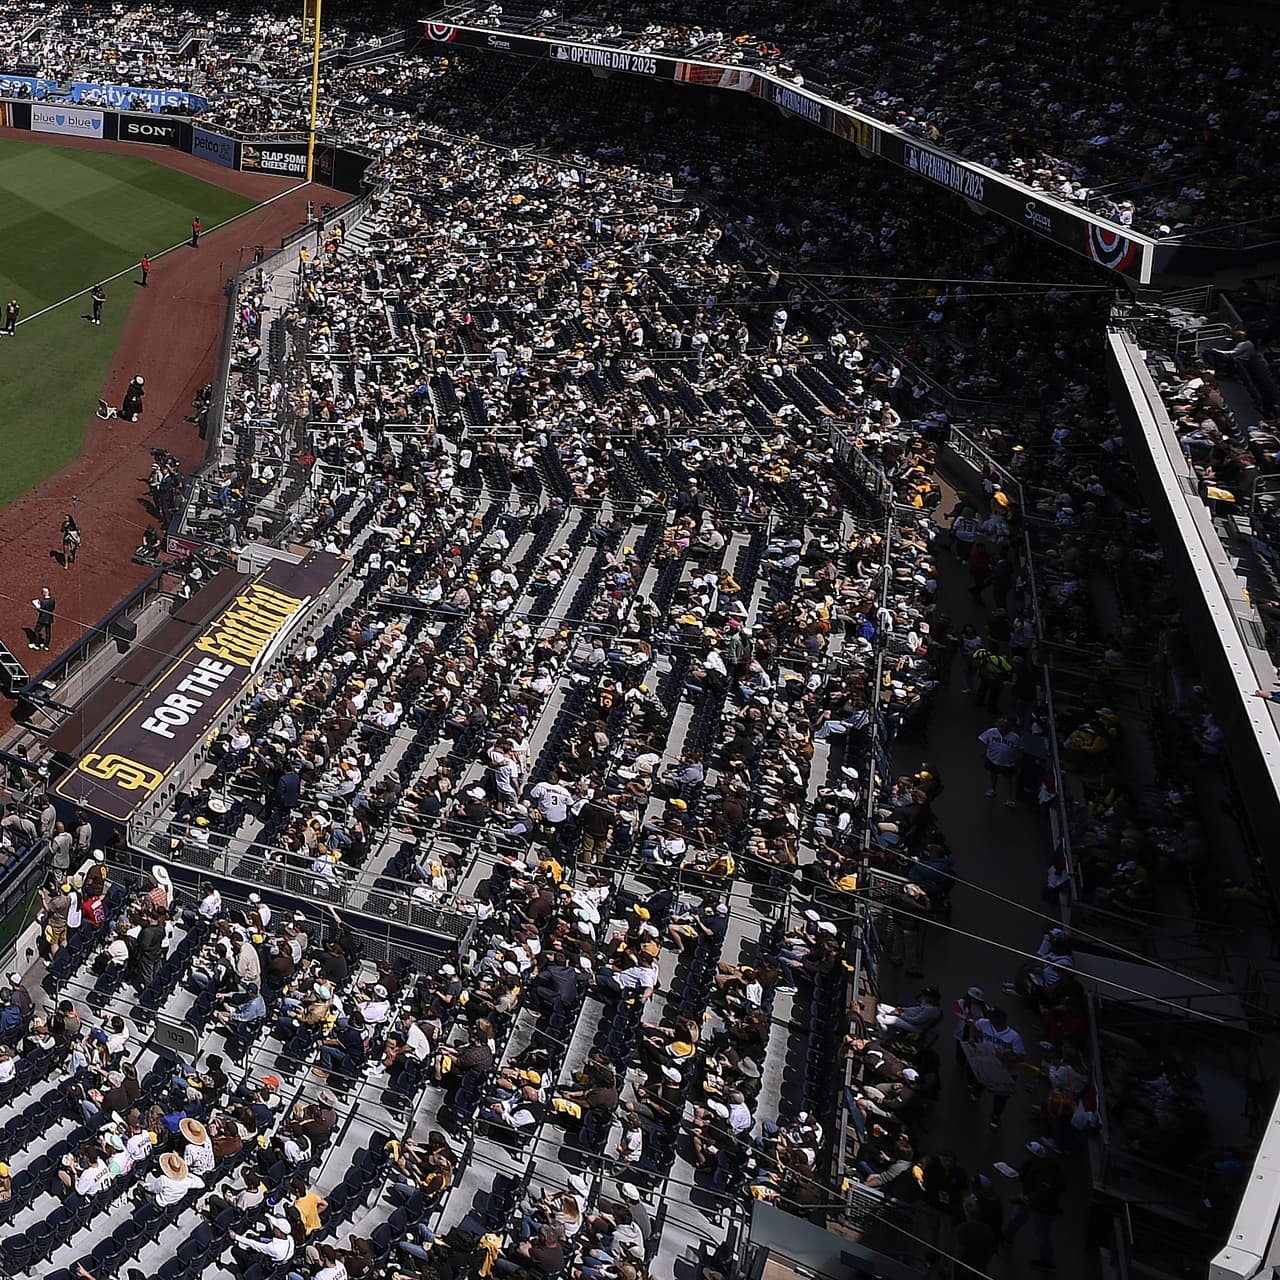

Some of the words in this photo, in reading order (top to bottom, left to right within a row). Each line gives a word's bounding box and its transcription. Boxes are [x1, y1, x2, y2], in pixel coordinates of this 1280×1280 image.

[571, 46, 612, 67] OPENING
[612, 53, 632, 71] DAY
[631, 57, 657, 75] 2025
[33, 112, 56, 124] blue
[68, 115, 91, 127] blue
[128, 123, 176, 139] SONY
[194, 134, 219, 153] petco
[261, 151, 284, 161] SLAP
[261, 161, 288, 170] CHEESE
[919, 150, 950, 185] OPENING
[950, 163, 965, 193] DAY
[964, 170, 984, 201] 2025
[141, 692, 203, 739] FOR
[185, 656, 235, 699] THE
[78, 753, 164, 792] SD
